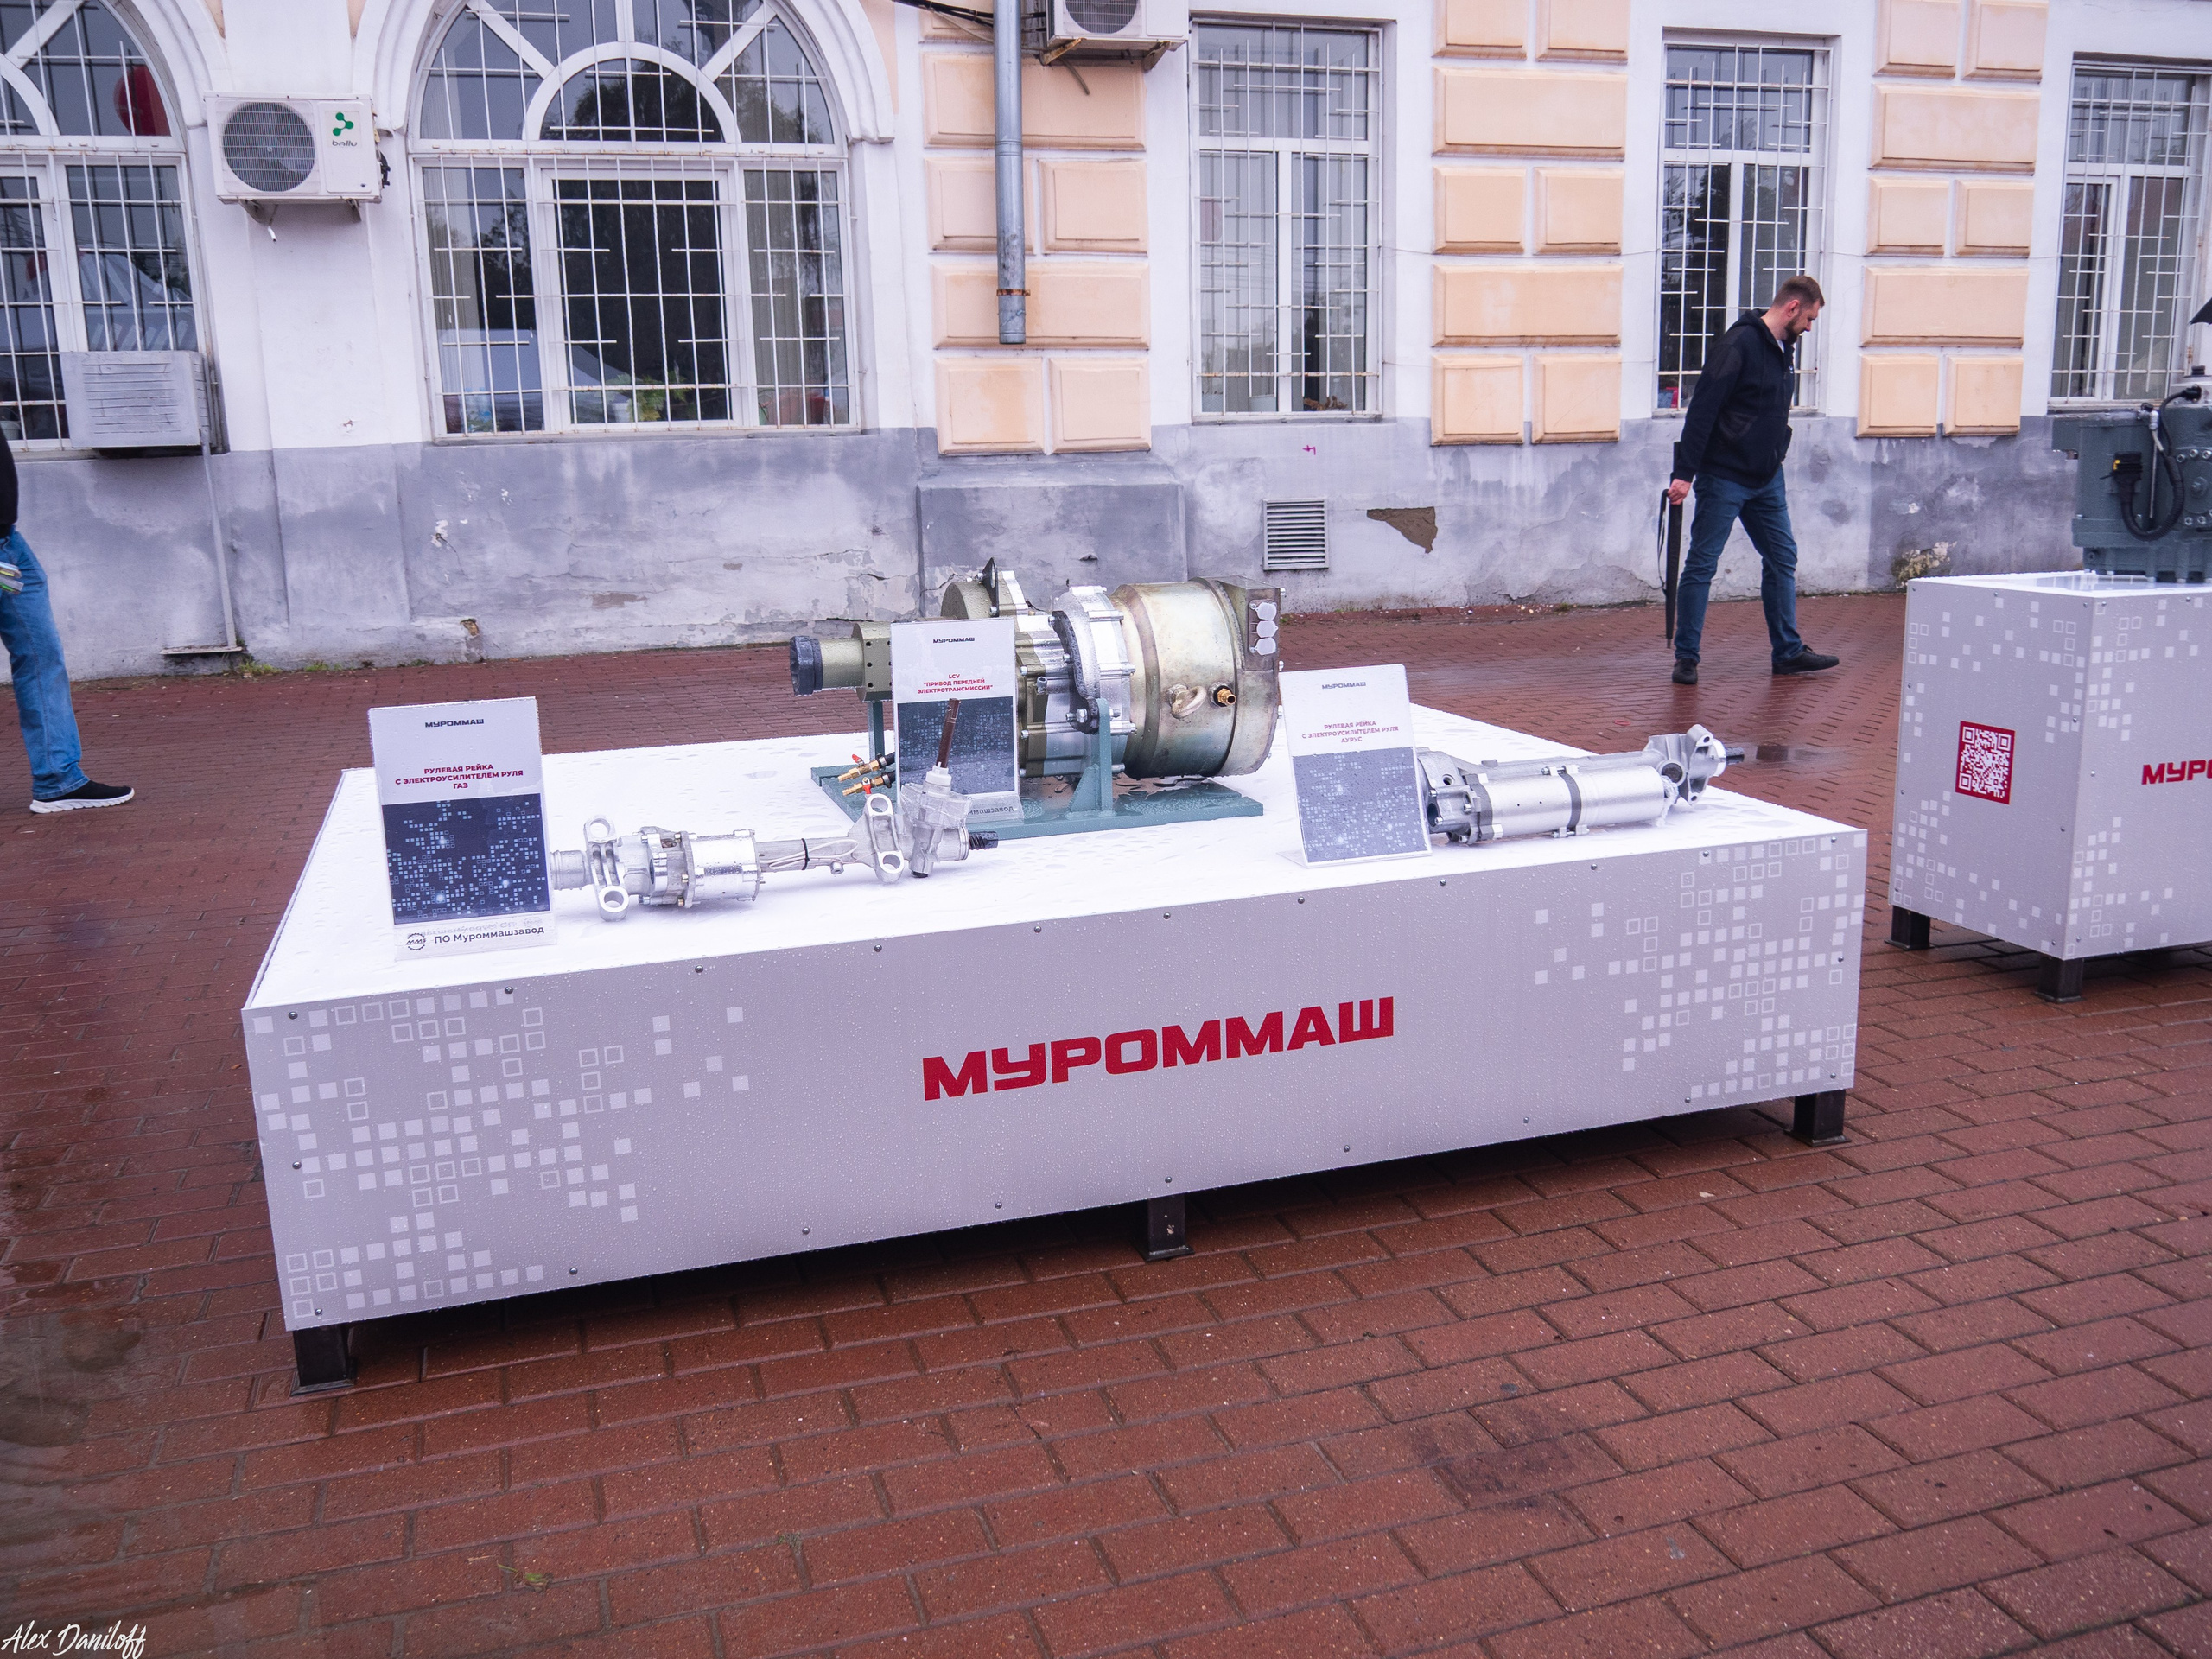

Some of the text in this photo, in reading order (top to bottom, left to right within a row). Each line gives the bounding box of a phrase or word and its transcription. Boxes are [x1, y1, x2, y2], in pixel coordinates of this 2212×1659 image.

[918, 684, 993, 694] ЭЛЕКТРОТРАНСМИССИИ"
[424, 718, 485, 728] МУРОММАШ
[1307, 728, 1381, 738] ЭЛЕКТРОУСИЛИТЕЛЕМ
[423, 763, 494, 774] РУЛЕВАЯ РЕЙКА
[2141, 759, 2212, 785] МУР
[403, 772, 499, 785] ЭЛЕКТРОУСИЛИТЕЛЕМ
[434, 935, 451, 944] ПО
[454, 926, 545, 943] Муроммашзавод
[922, 996, 1394, 1101] МУРОММАШ
